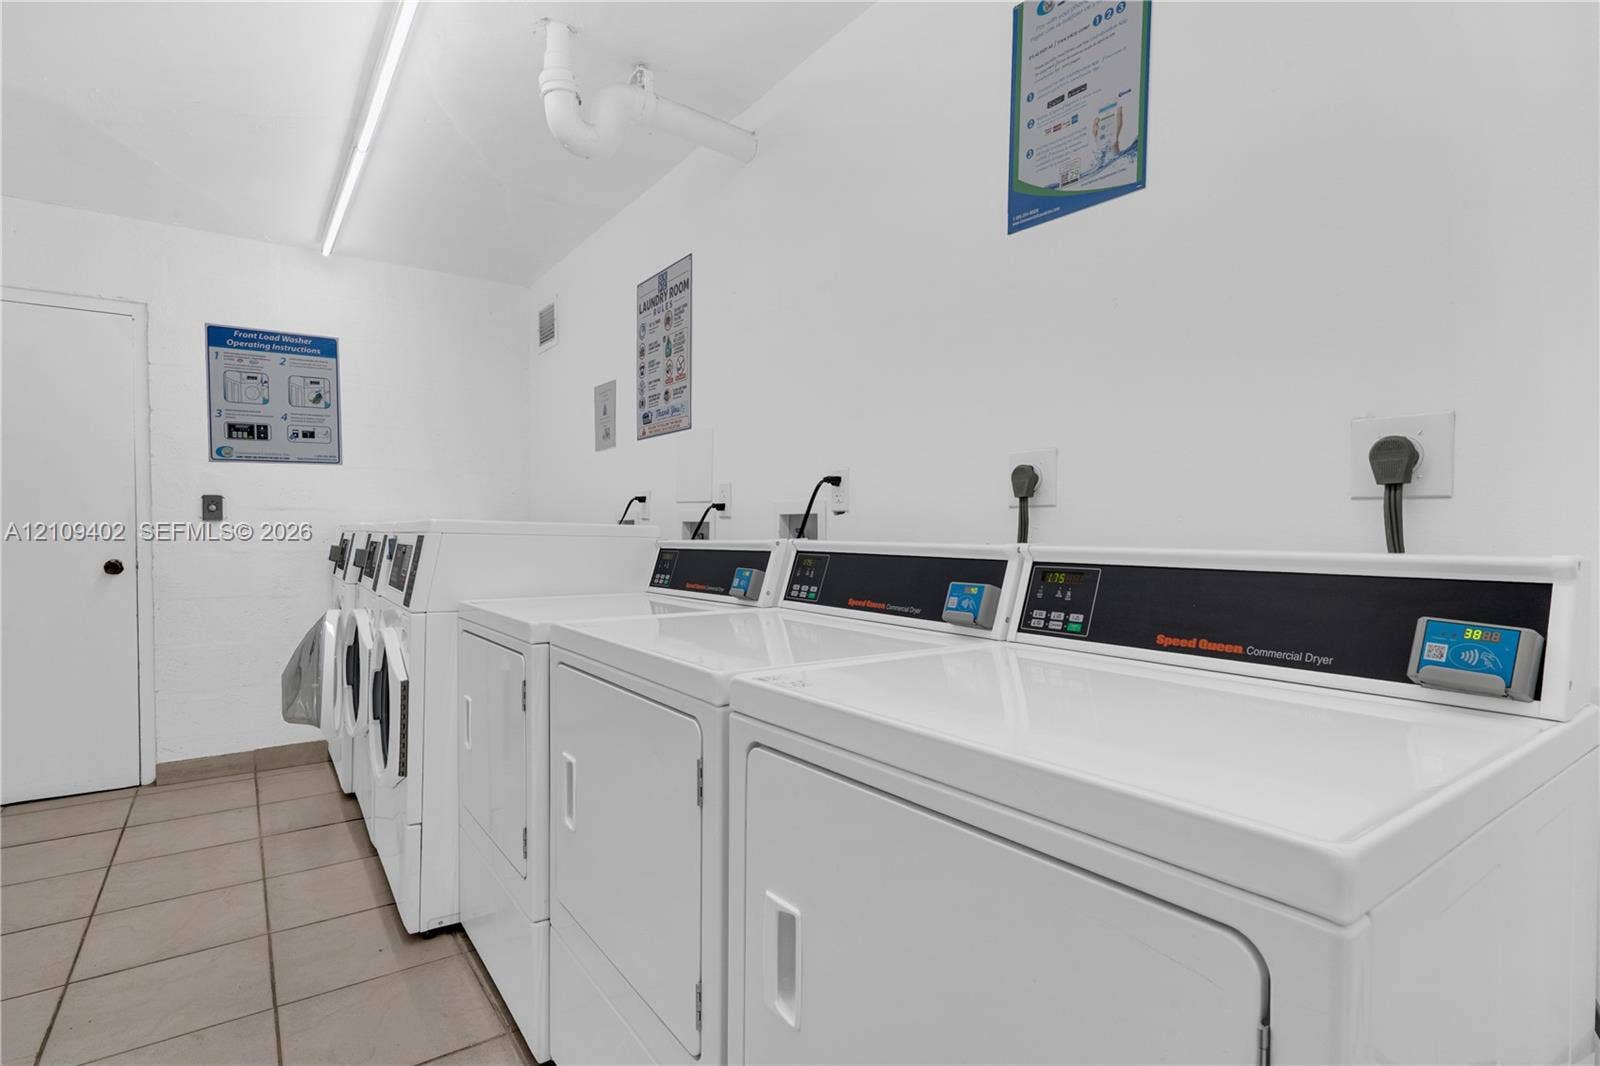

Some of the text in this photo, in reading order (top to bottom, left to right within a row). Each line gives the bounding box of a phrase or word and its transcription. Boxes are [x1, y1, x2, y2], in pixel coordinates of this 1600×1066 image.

[639, 290, 668, 315] LAUNDRY
[669, 278, 690, 301] ROOM
[653, 300, 673, 316] RULES
[233, 330, 312, 345] Front Load Washer
[226, 339, 321, 354] Operating Instructions
[214, 351, 219, 360] 1
[280, 358, 287, 366] 2
[215, 409, 222, 418] 3
[281, 413, 288, 421] 4
[1156, 634, 1335, 665] Speed Queen Commercial Dryer
